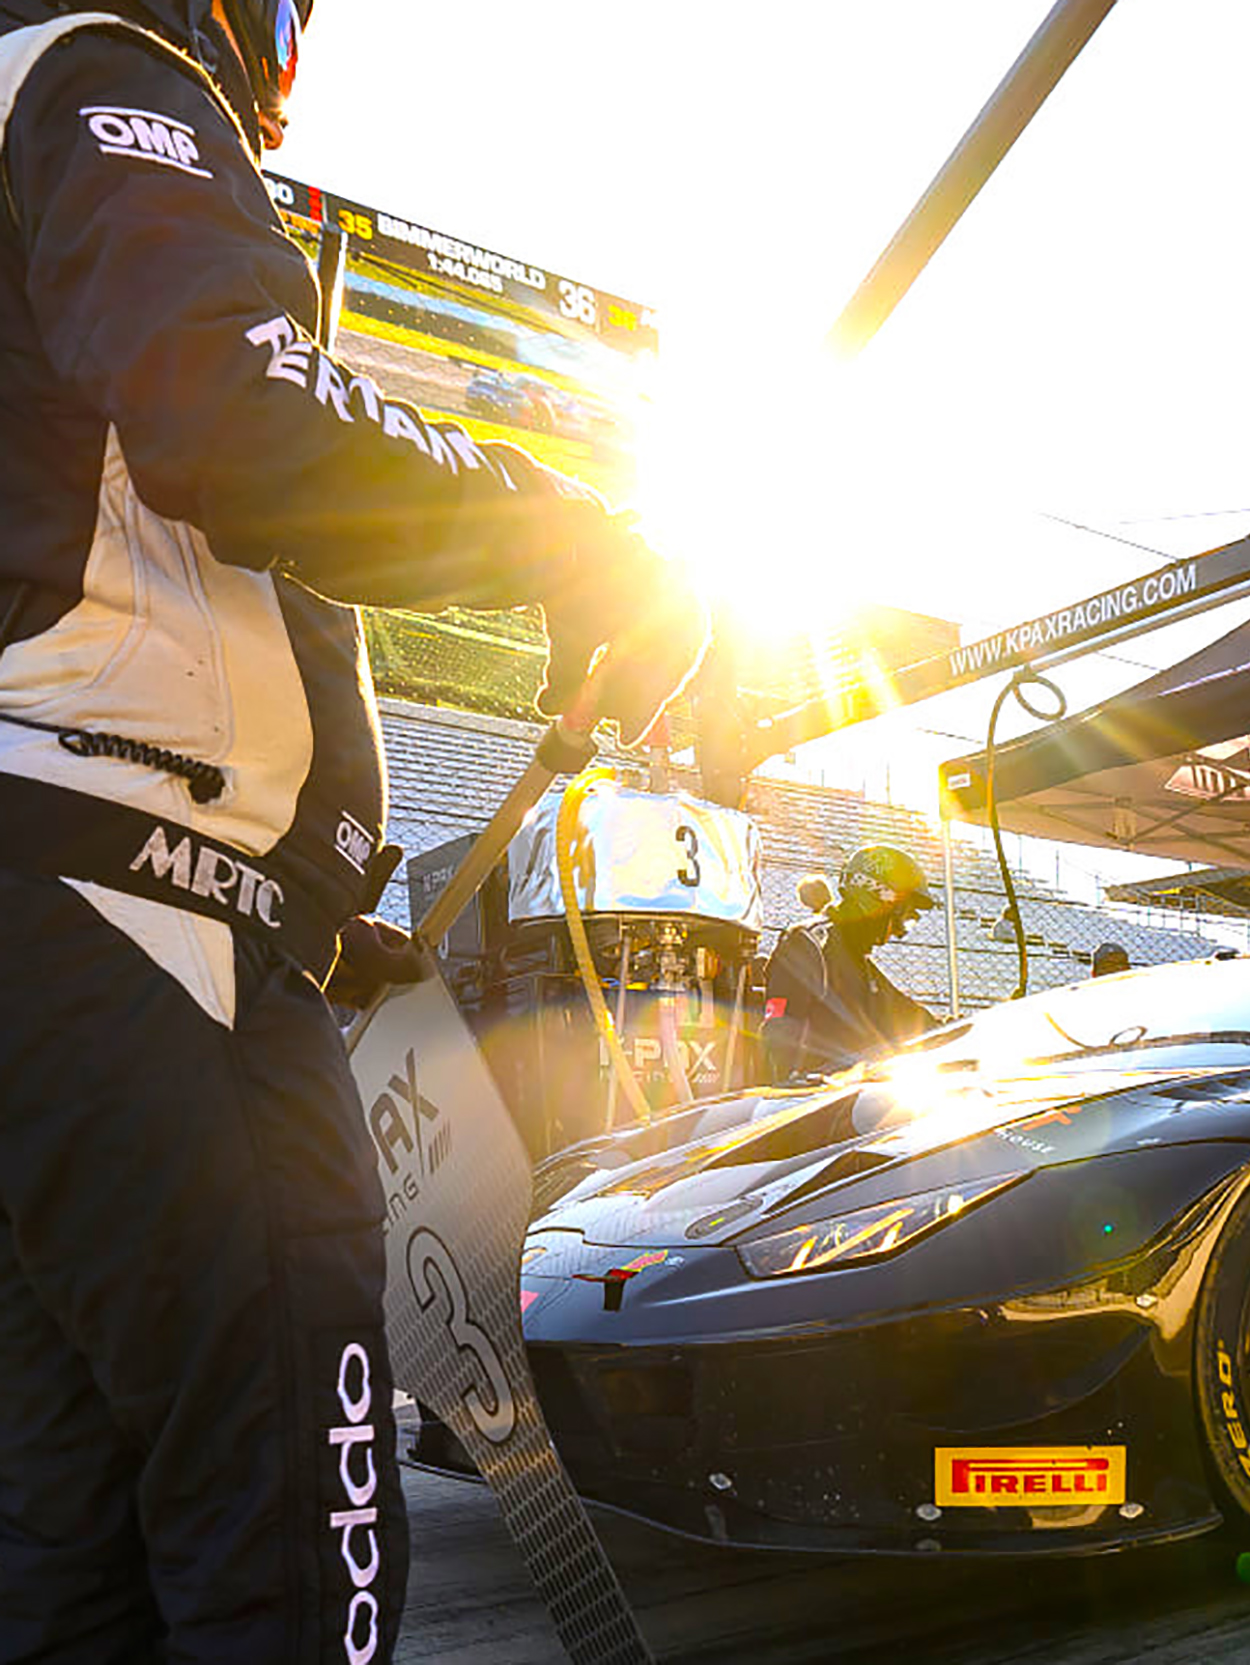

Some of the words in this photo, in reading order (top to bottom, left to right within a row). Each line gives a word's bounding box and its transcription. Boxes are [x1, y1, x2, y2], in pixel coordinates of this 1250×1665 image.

[89, 113, 199, 165] OMP
[337, 208, 374, 241] 35
[377, 211, 547, 290] BIMMERWORLD
[557, 279, 597, 327] 36
[949, 563, 1197, 677] WWW.KPAXRACING.COM
[128, 825, 285, 929] MRTC
[675, 825, 701, 888] 3
[406, 1225, 517, 1445] 3
[951, 1457, 1110, 1494] PIRELLI
